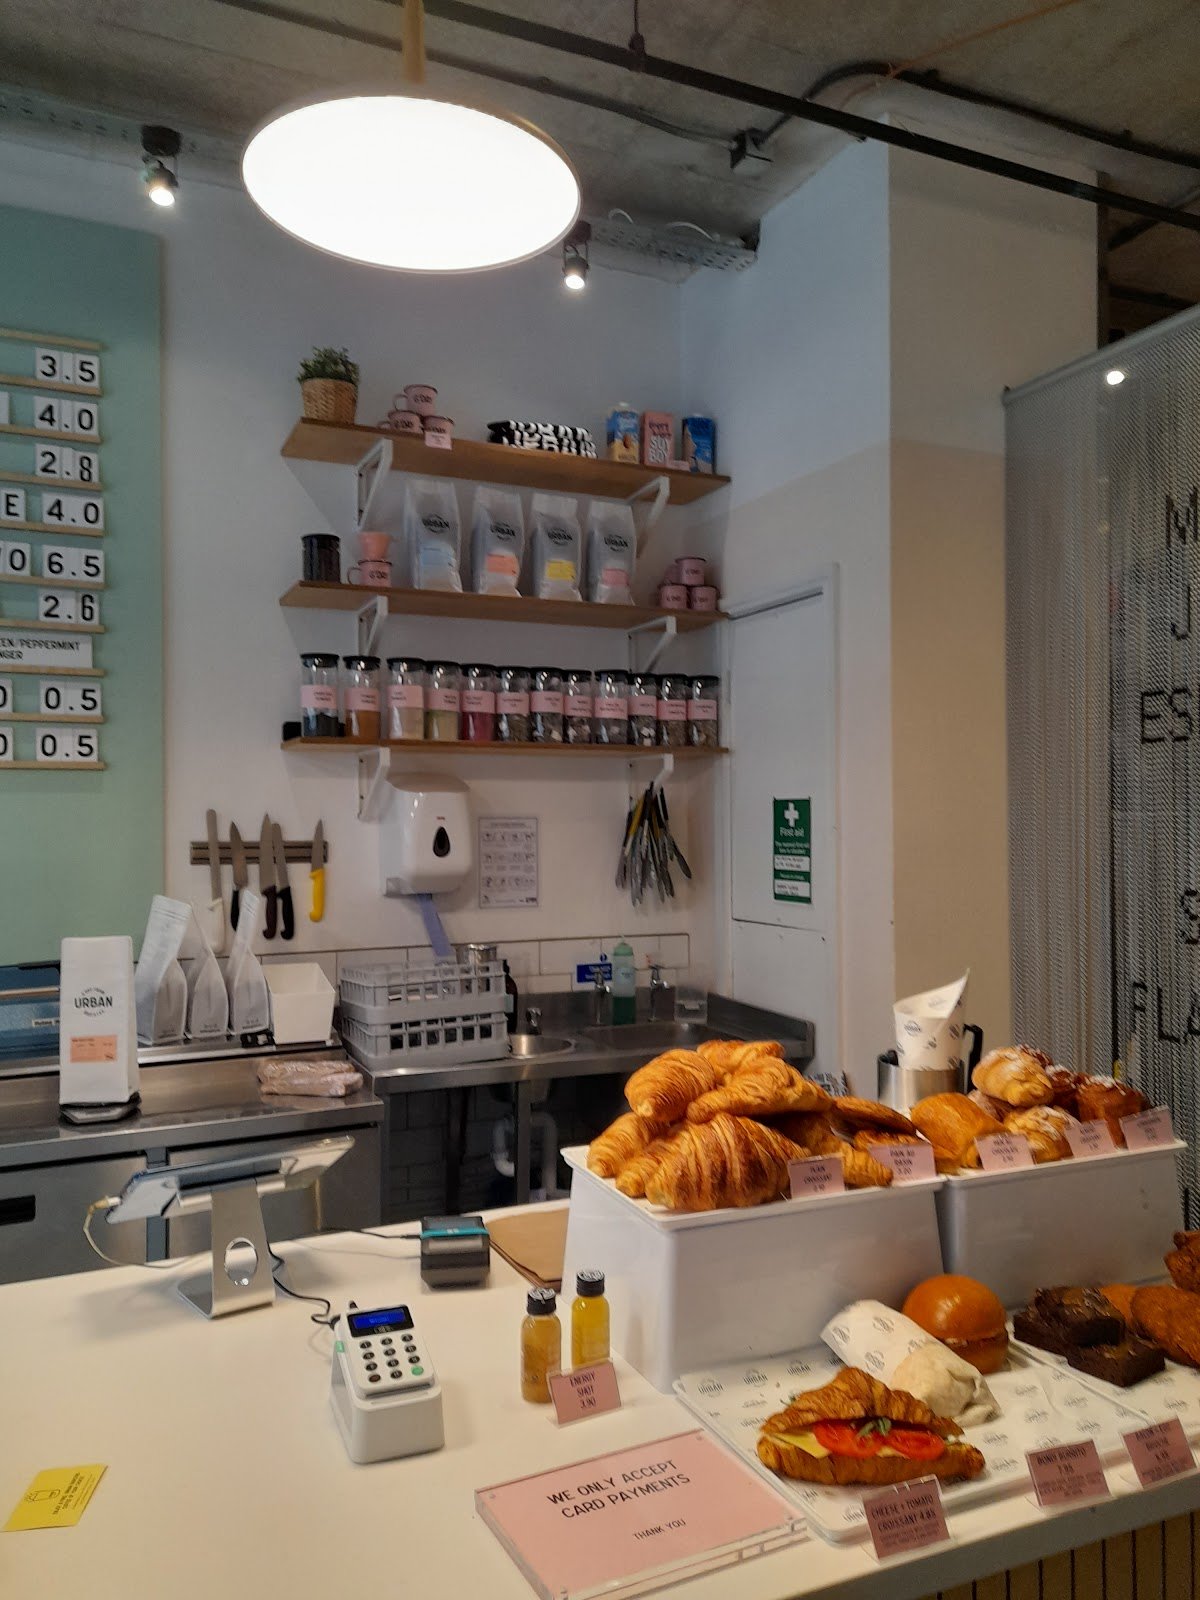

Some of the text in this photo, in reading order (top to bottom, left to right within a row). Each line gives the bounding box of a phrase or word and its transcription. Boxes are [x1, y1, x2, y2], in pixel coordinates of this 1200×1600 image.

[39, 354, 96, 383] 3.5
[38, 404, 94, 431] 4.0
[39, 450, 93, 483] 2.8
[46, 498, 100, 525] 4.0
[47, 552, 101, 577] 6.5
[42, 593, 95, 622] 2.6
[44, 686, 99, 711] 0.5
[41, 733, 95, 758] 0.5
[74, 995, 113, 1009] URBAN
[546, 1458, 678, 1505] WE ONLY ACCEPT
[560, 1472, 691, 1519] CARD PAYMENTS
[632, 1517, 687, 1541] THANK YOU
